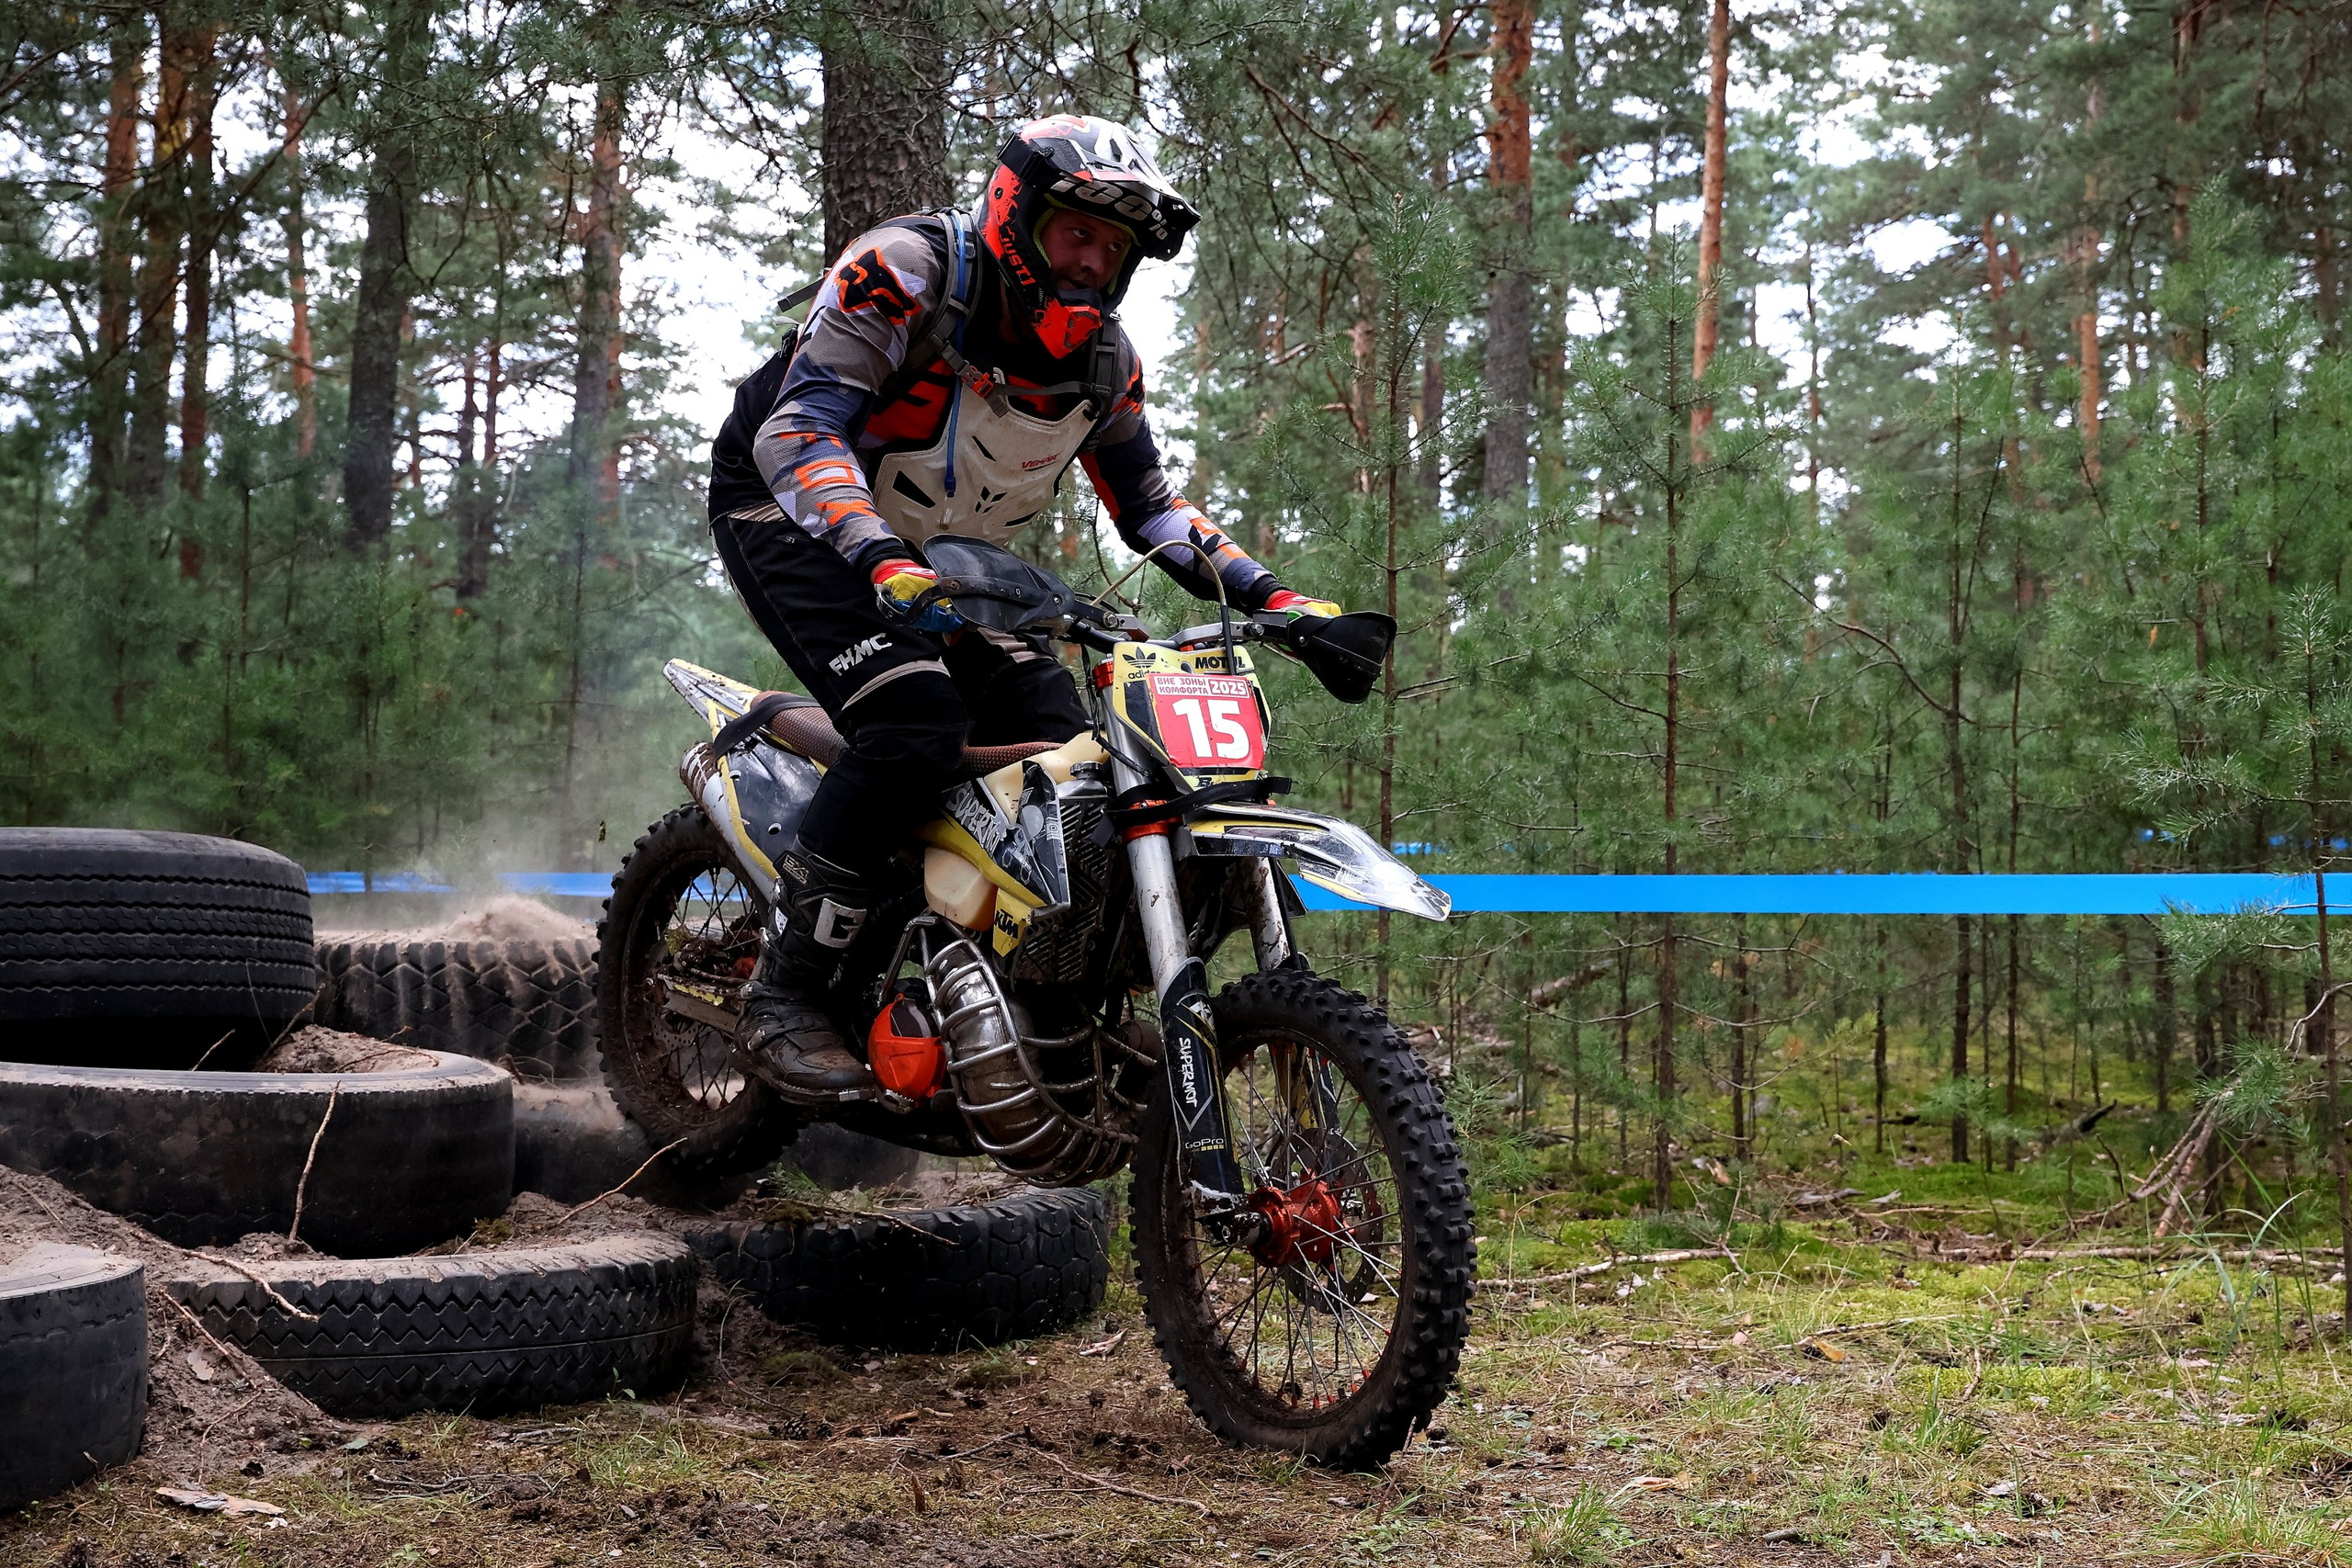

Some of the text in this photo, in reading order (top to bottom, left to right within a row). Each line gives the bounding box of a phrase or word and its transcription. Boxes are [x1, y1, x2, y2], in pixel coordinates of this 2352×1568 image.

[1159, 686, 1208, 694] КОМФОРТА
[1210, 681, 1247, 695] 2025
[1172, 699, 1250, 759] 15
[994, 908, 1019, 939] KTM
[1179, 1038, 1198, 1108] SUPERMOT
[1185, 1138, 1224, 1149] GoPro
